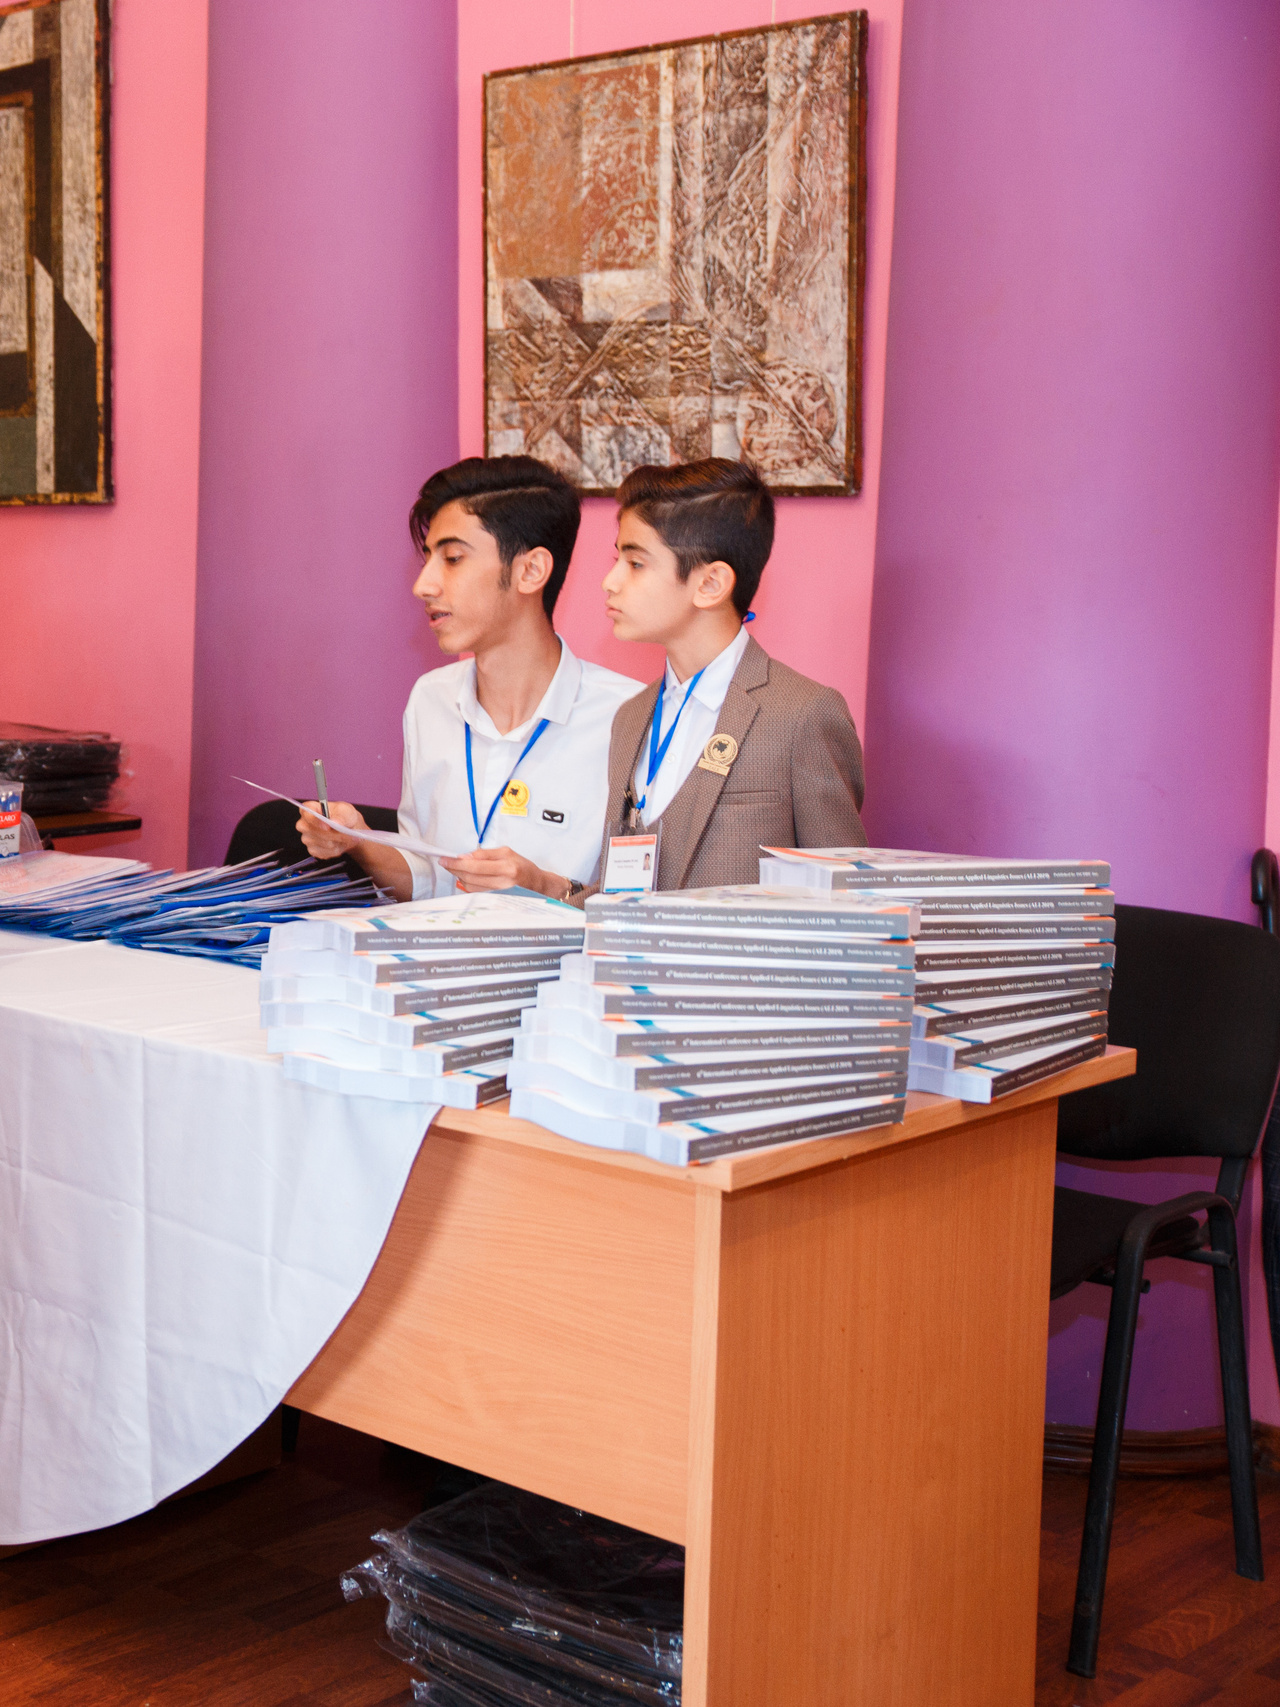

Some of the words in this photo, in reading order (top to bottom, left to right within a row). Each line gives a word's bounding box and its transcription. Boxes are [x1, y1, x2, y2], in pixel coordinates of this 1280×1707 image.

[736, 915, 757, 924] Applied
[666, 941, 702, 949] International
[702, 942, 734, 950] Conference
[743, 944, 764, 953] Applied
[764, 945, 794, 954] Linguistics
[750, 974, 770, 982] Applied
[756, 1004, 775, 1012] Applied
